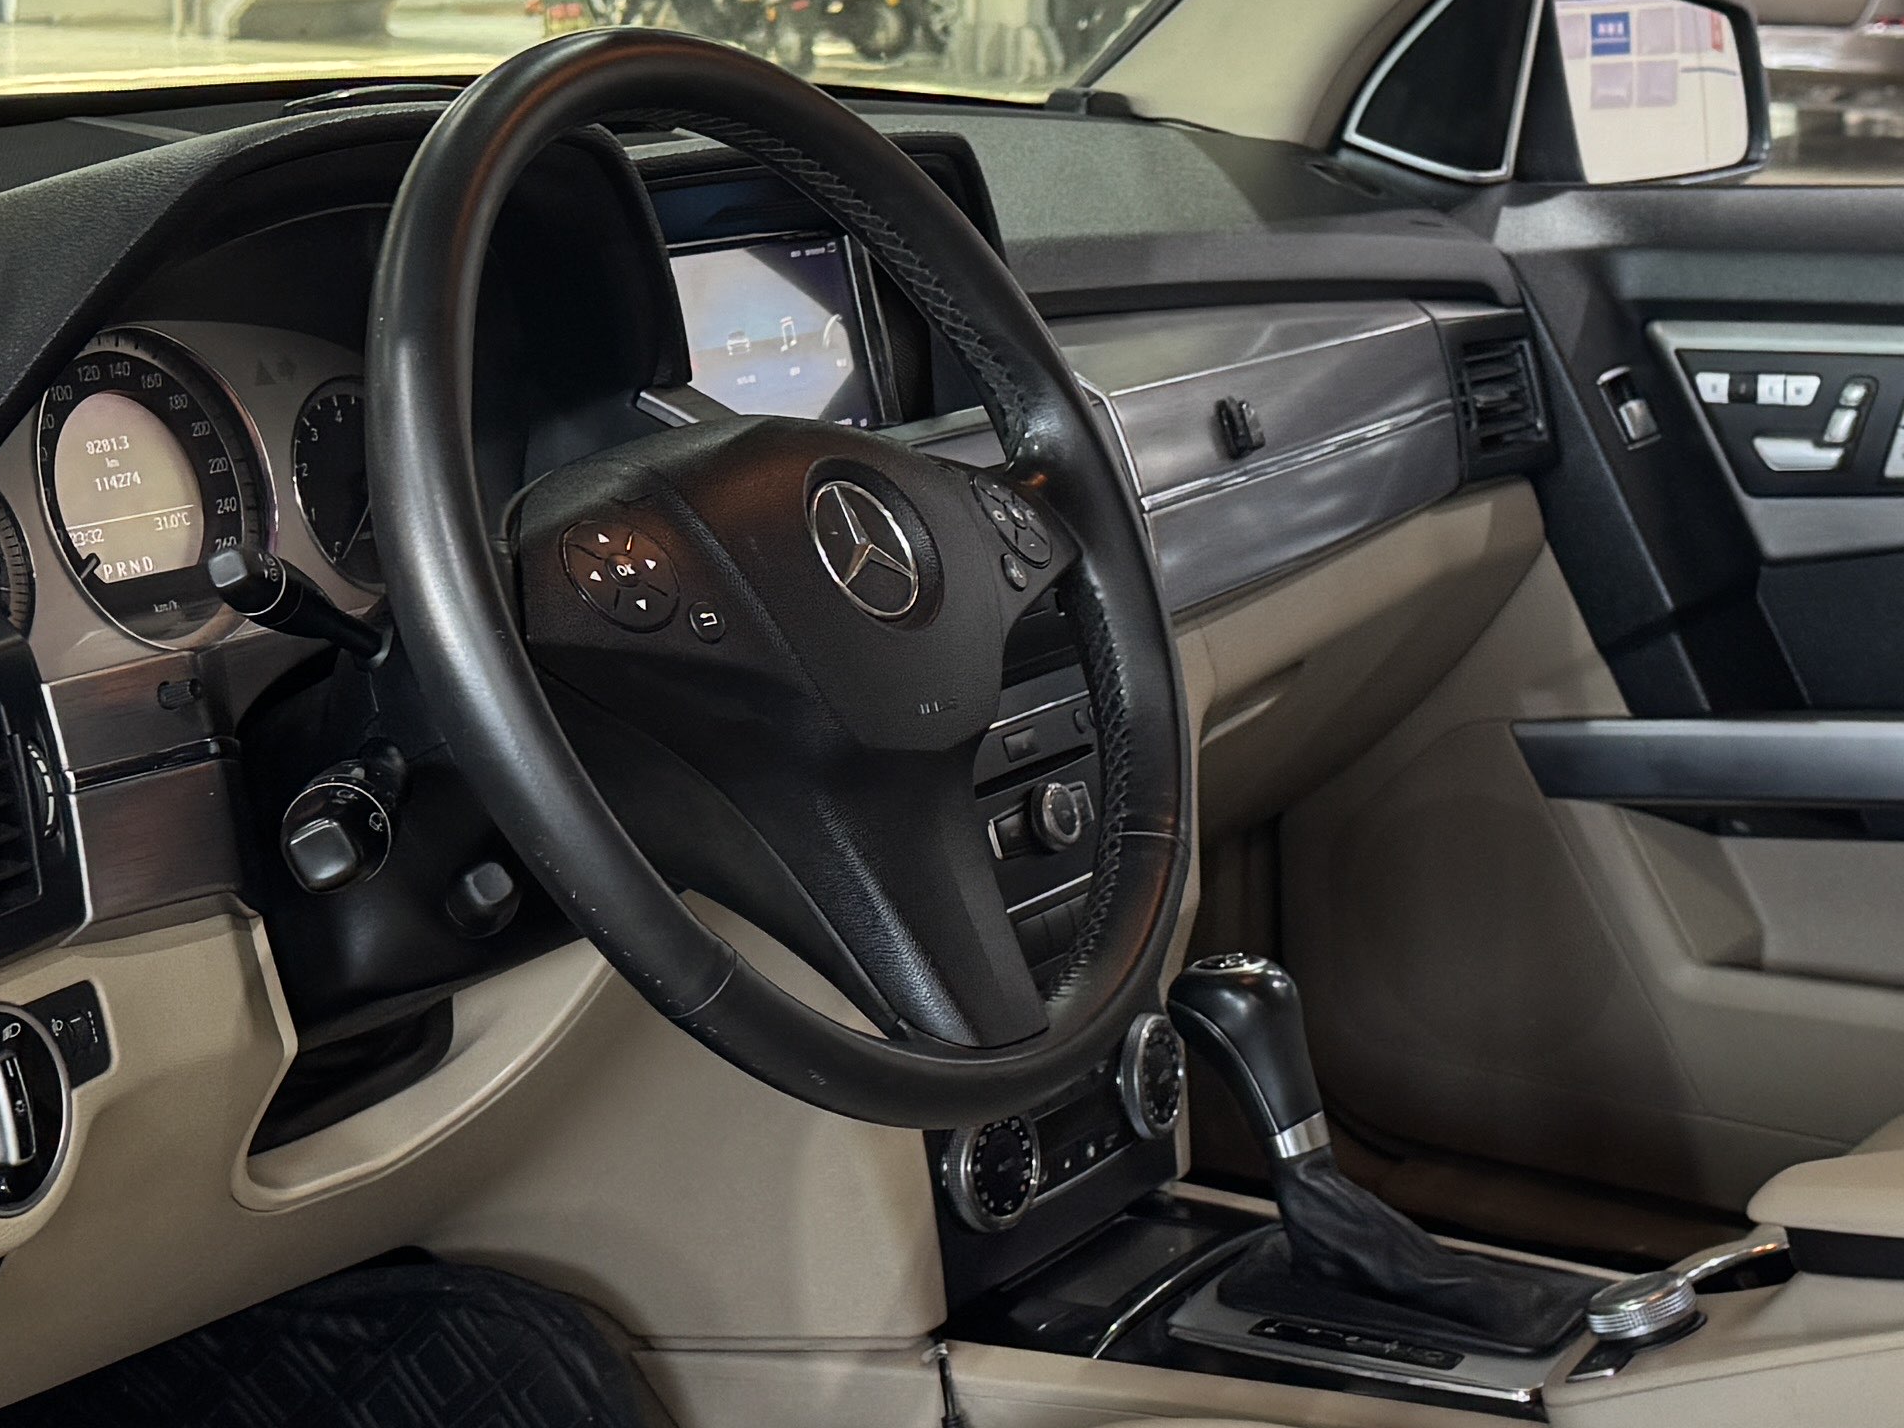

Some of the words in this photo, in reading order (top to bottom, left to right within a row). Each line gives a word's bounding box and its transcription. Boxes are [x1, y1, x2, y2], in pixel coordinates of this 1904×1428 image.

[77, 365, 101, 382] 120
[109, 361, 131, 379] 140
[51, 385, 73, 402] 100
[310, 428, 319, 441] 3
[301, 462, 309, 477] 2
[95, 471, 142, 492] 114274
[215, 498, 237, 514] 240
